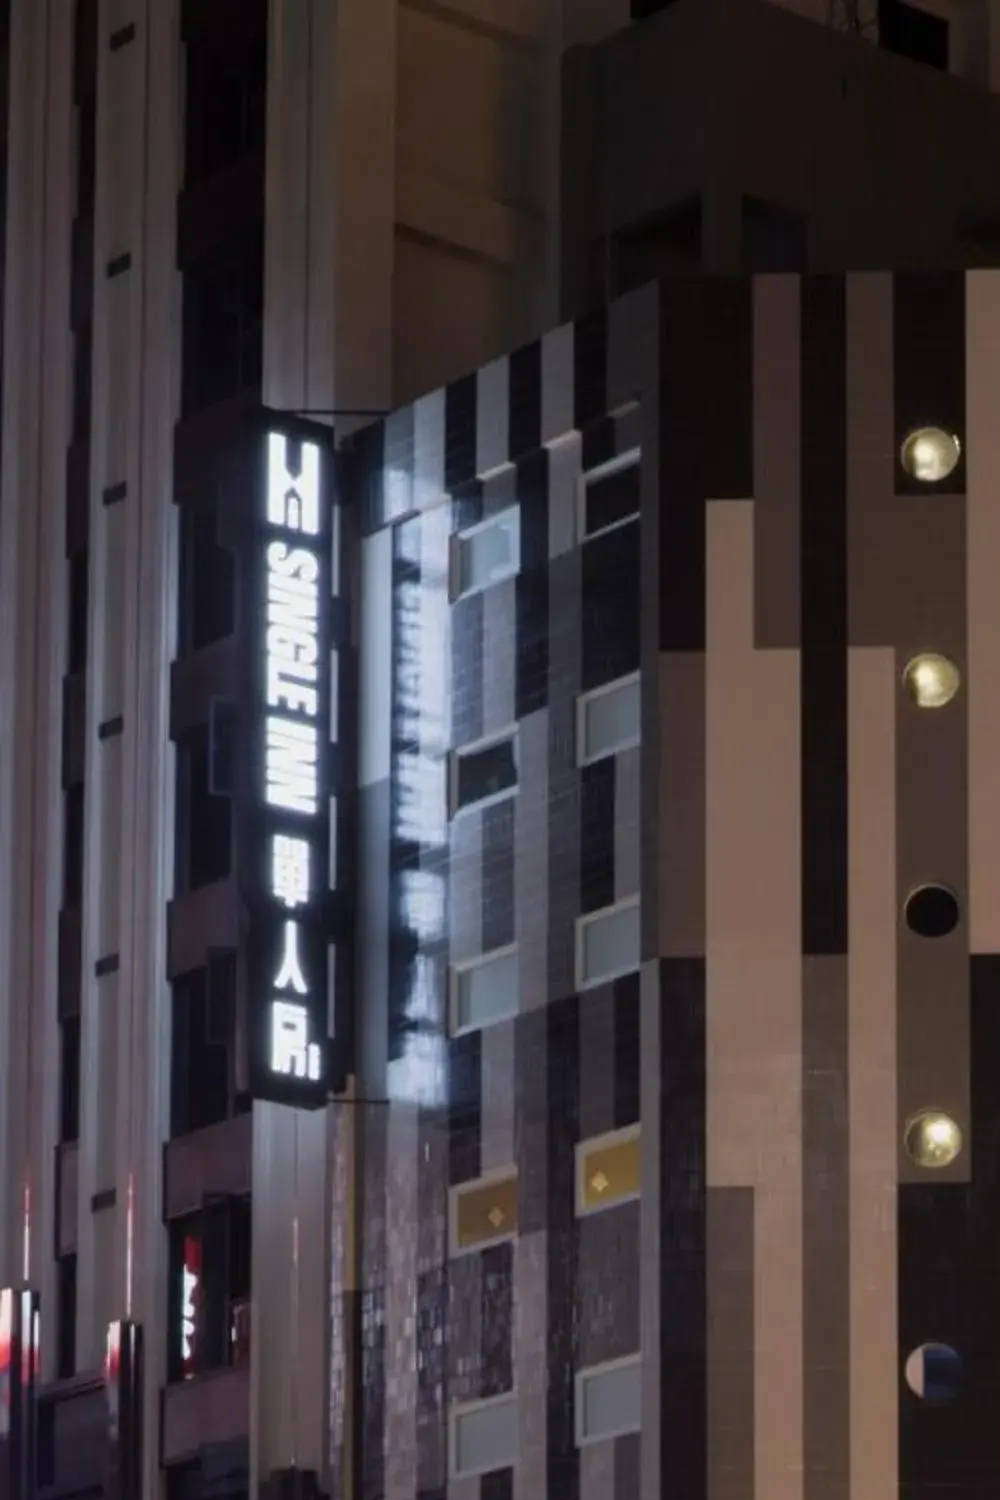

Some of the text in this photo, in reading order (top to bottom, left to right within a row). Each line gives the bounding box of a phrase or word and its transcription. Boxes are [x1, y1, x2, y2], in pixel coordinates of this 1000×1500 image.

[266, 541, 319, 716] SINGLE
[265, 716, 318, 814] INN
[272, 834, 321, 1081] 單人房
